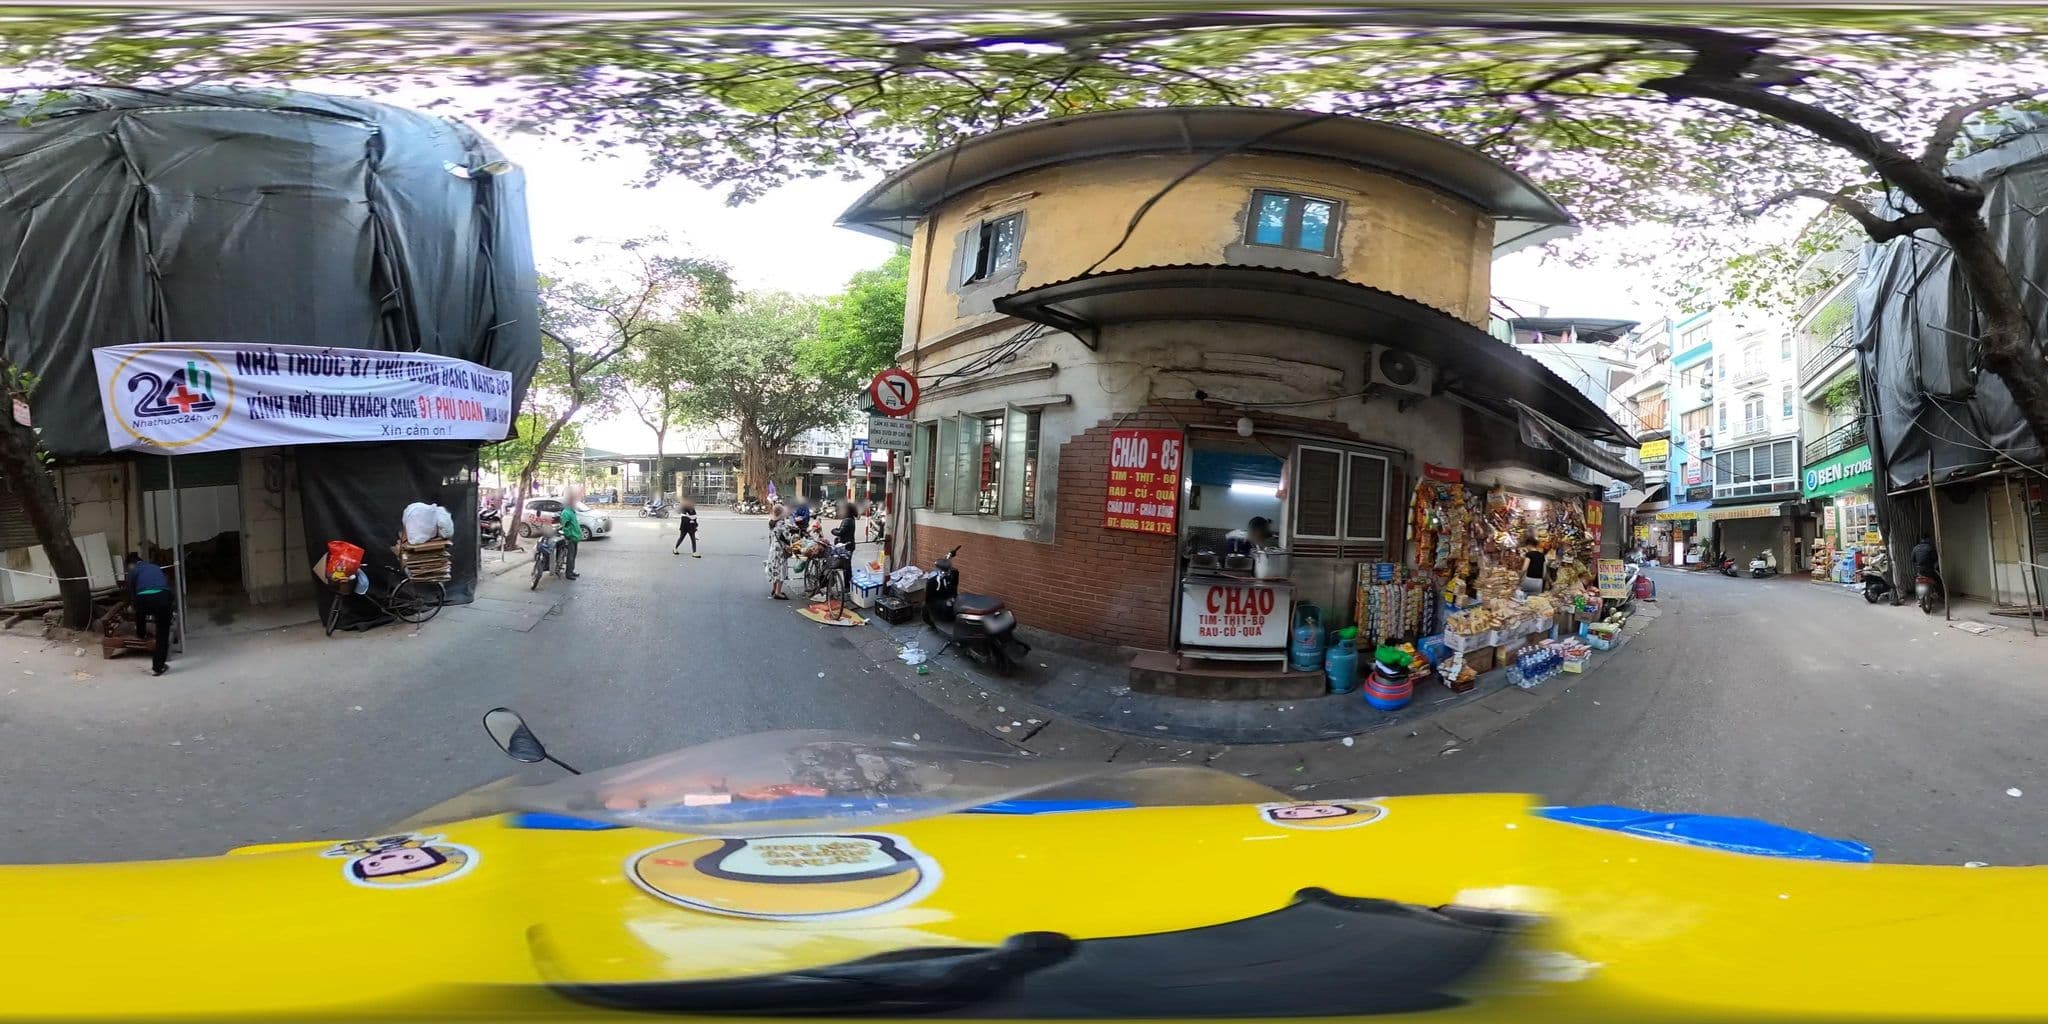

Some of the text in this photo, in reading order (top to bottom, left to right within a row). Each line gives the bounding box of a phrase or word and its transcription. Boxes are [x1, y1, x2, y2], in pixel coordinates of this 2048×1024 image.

[236, 347, 280, 376] NHÀ
[286, 347, 345, 377] THUỐC
[350, 355, 370, 378] 87
[247, 390, 285, 420] KÍNH
[350, 392, 388, 419] KHÁCH
[391, 398, 418, 418] SANG
[419, 395, 432, 419] 91
[381, 424, 402, 436] Xin
[1112, 432, 1148, 469] CHÁO
[1161, 439, 1180, 470] 85
[1111, 471, 1127, 480] TIM
[1136, 472, 1155, 484] THỊT
[1818, 458, 1873, 486] BEN STORE
[1108, 487, 1126, 496] RAU
[1134, 484, 1148, 498] CỦ
